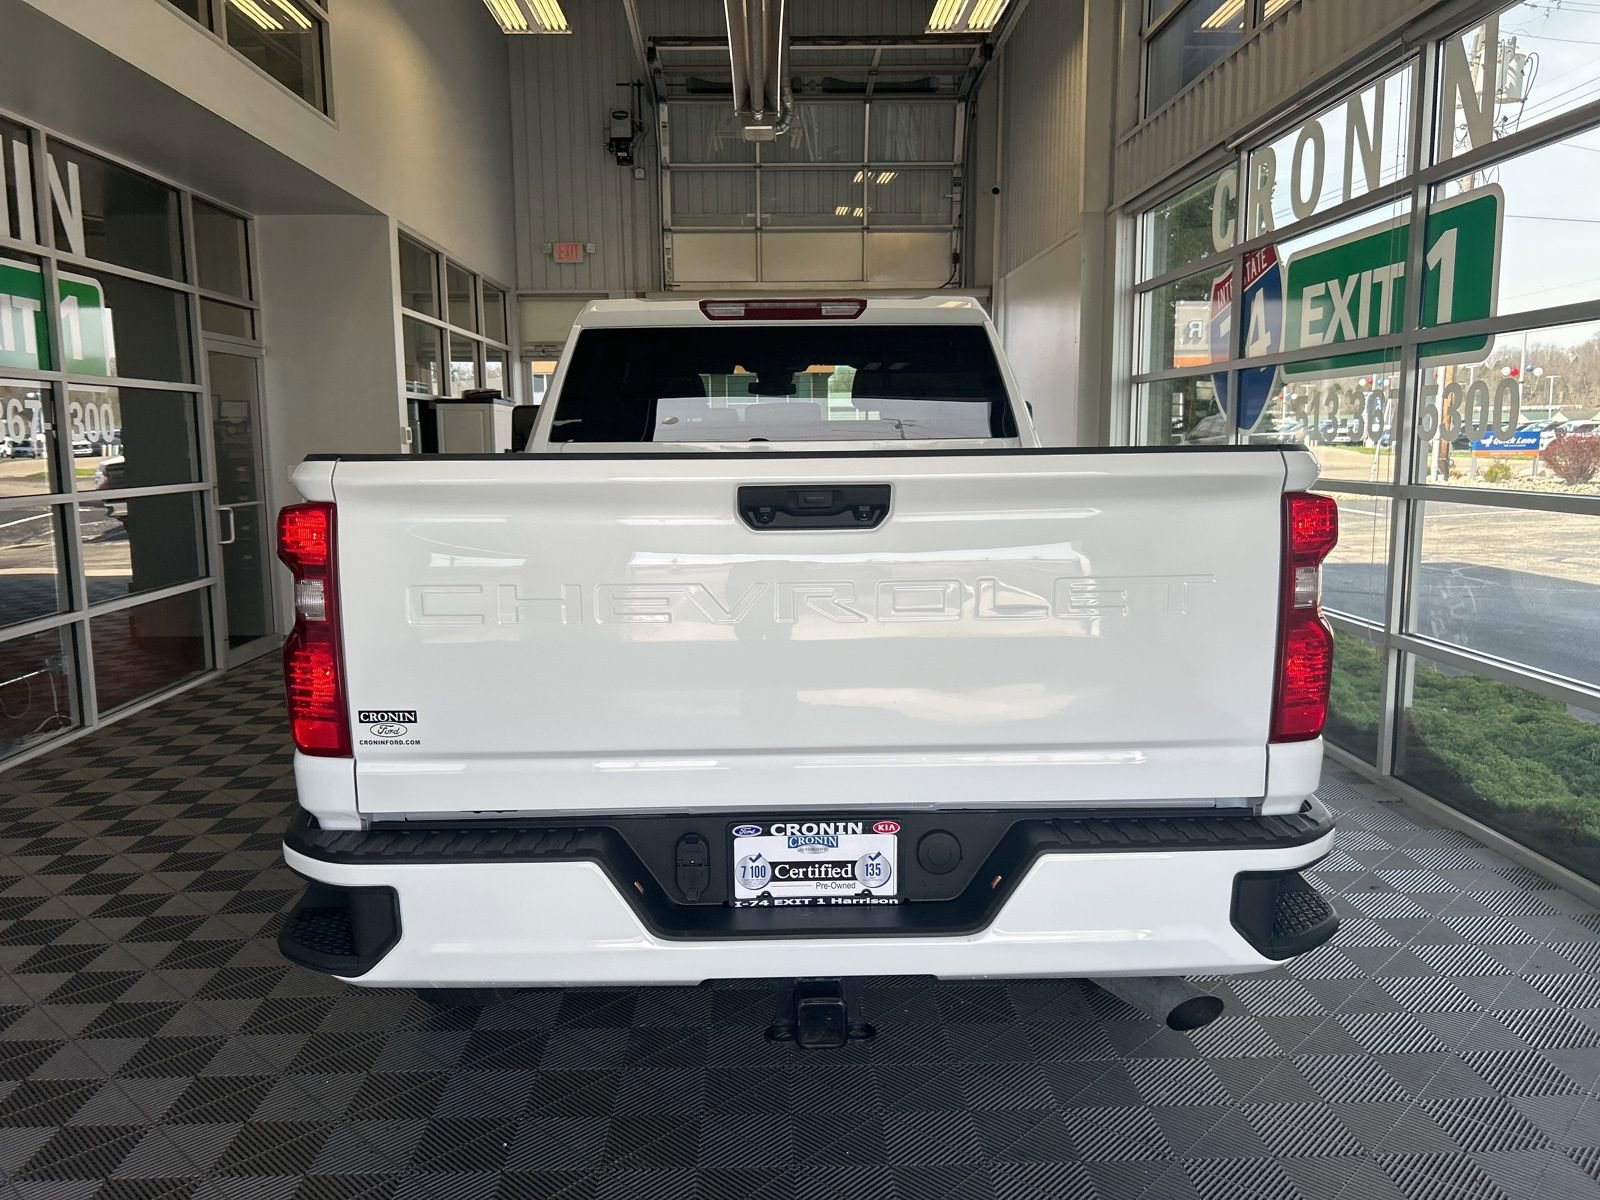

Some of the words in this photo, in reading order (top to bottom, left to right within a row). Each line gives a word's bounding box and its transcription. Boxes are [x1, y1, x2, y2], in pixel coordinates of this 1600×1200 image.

[0, 134, 86, 257] IN
[558, 244, 581, 259] EXIT
[1302, 262, 1404, 344] EXIT
[1427, 228, 1457, 324] 1
[0, 293, 41, 354] IT
[60, 295, 83, 361] 1
[406, 574, 1218, 625] CHEVROLET
[360, 712, 415, 722] CRONIN
[377, 724, 401, 735] Ford
[770, 822, 863, 836] CRONIN
[877, 824, 897, 832] KIA
[789, 836, 837, 848] CRONIN
[750, 865, 766, 878] 100
[774, 864, 853, 879] Certified
[865, 862, 881, 877] 135
[815, 882, 856, 890] Pre-Owned
[734, 899, 770, 908] I-74
[774, 898, 812, 906] EXIT
[816, 897, 826, 905] 1
[830, 897, 899, 905] Harrison
